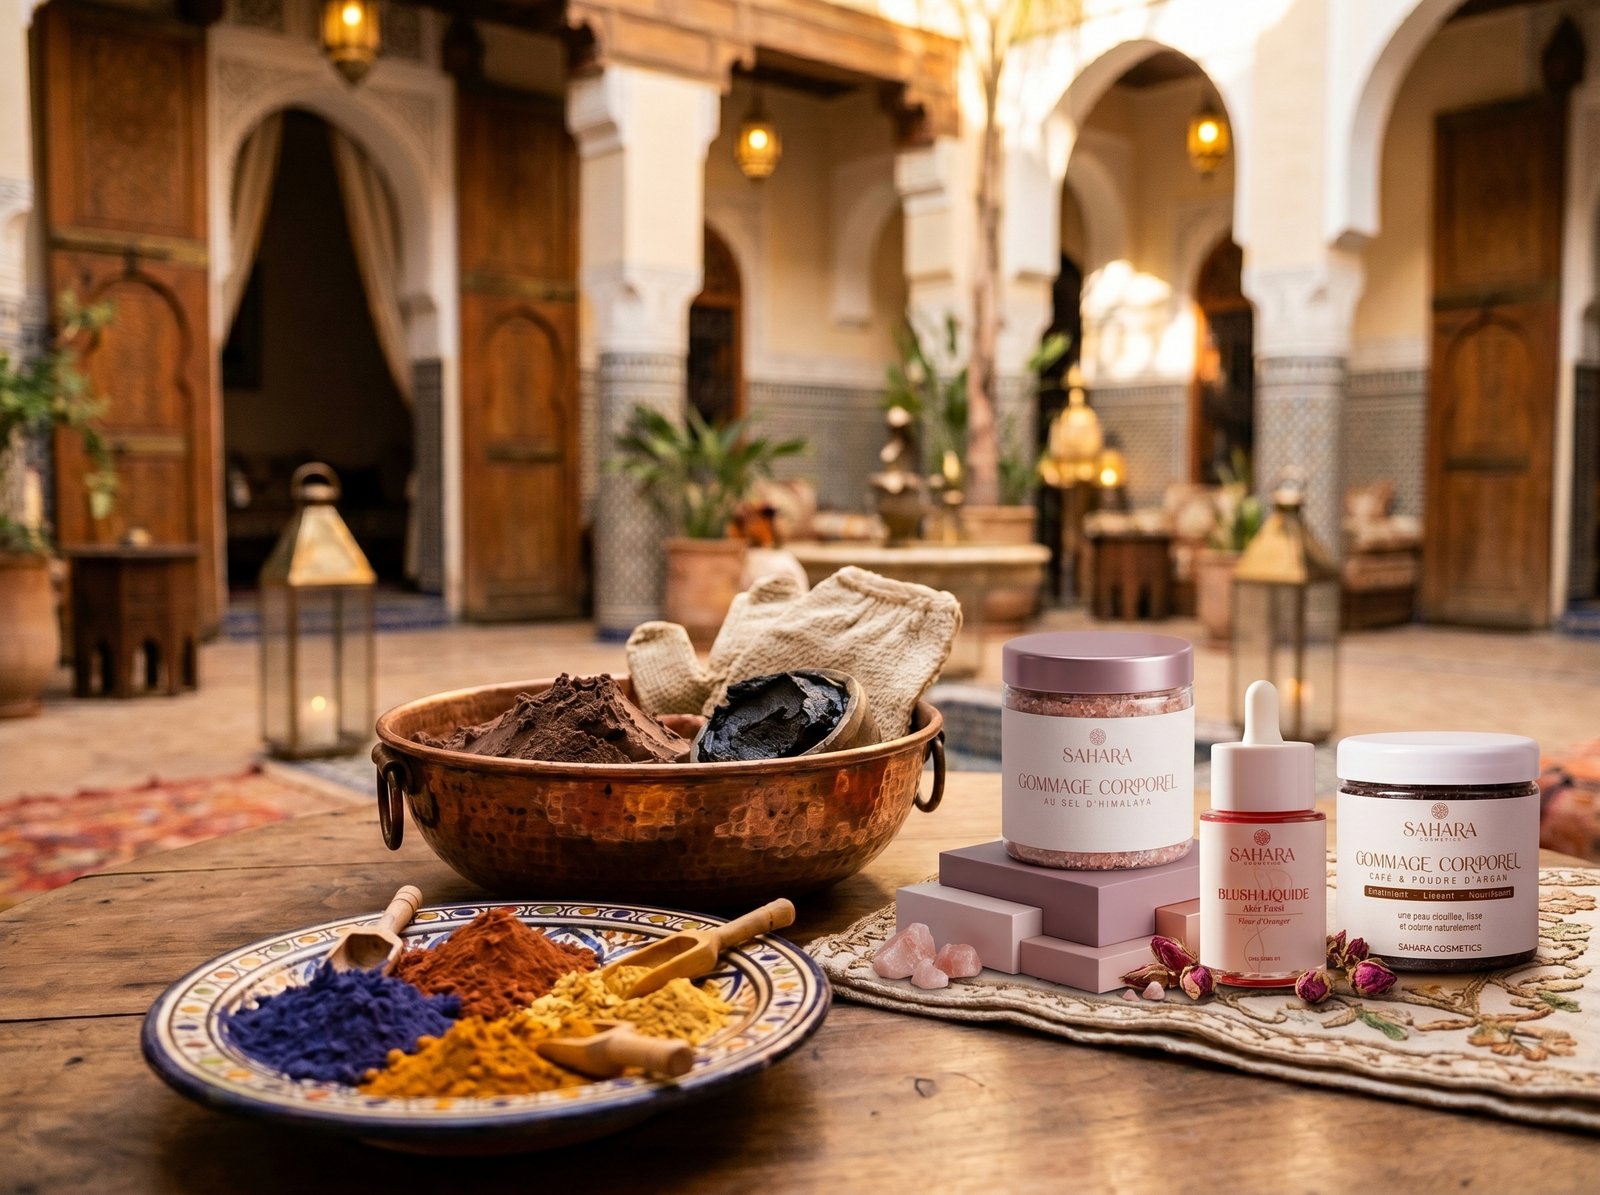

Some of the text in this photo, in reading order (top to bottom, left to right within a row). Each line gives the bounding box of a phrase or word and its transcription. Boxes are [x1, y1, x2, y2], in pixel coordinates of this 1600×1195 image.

[1062, 747, 1133, 766] SAHARA
[1018, 772, 1179, 796] GOMMAGE CORPOREL
[1043, 798, 1152, 808] AU SEL D'HIMALAYA
[1403, 821, 1478, 839] SAHARA
[1229, 847, 1296, 863] SAHARA
[1355, 850, 1522, 874] GOMMAGE CORPOREL
[1369, 872, 1508, 885] CAFÉ & POUDRE D'ARGAN
[1218, 888, 1310, 903] BLUSH LIQUIDE
[1256, 918, 1291, 927] d'Oranger
[1397, 912, 1411, 920] une
[1412, 912, 1431, 922] peau
[1466, 912, 1483, 920] lisse
[1399, 923, 1407, 931] et
[1398, 942, 1482, 953] SAHARA COSMETICS
